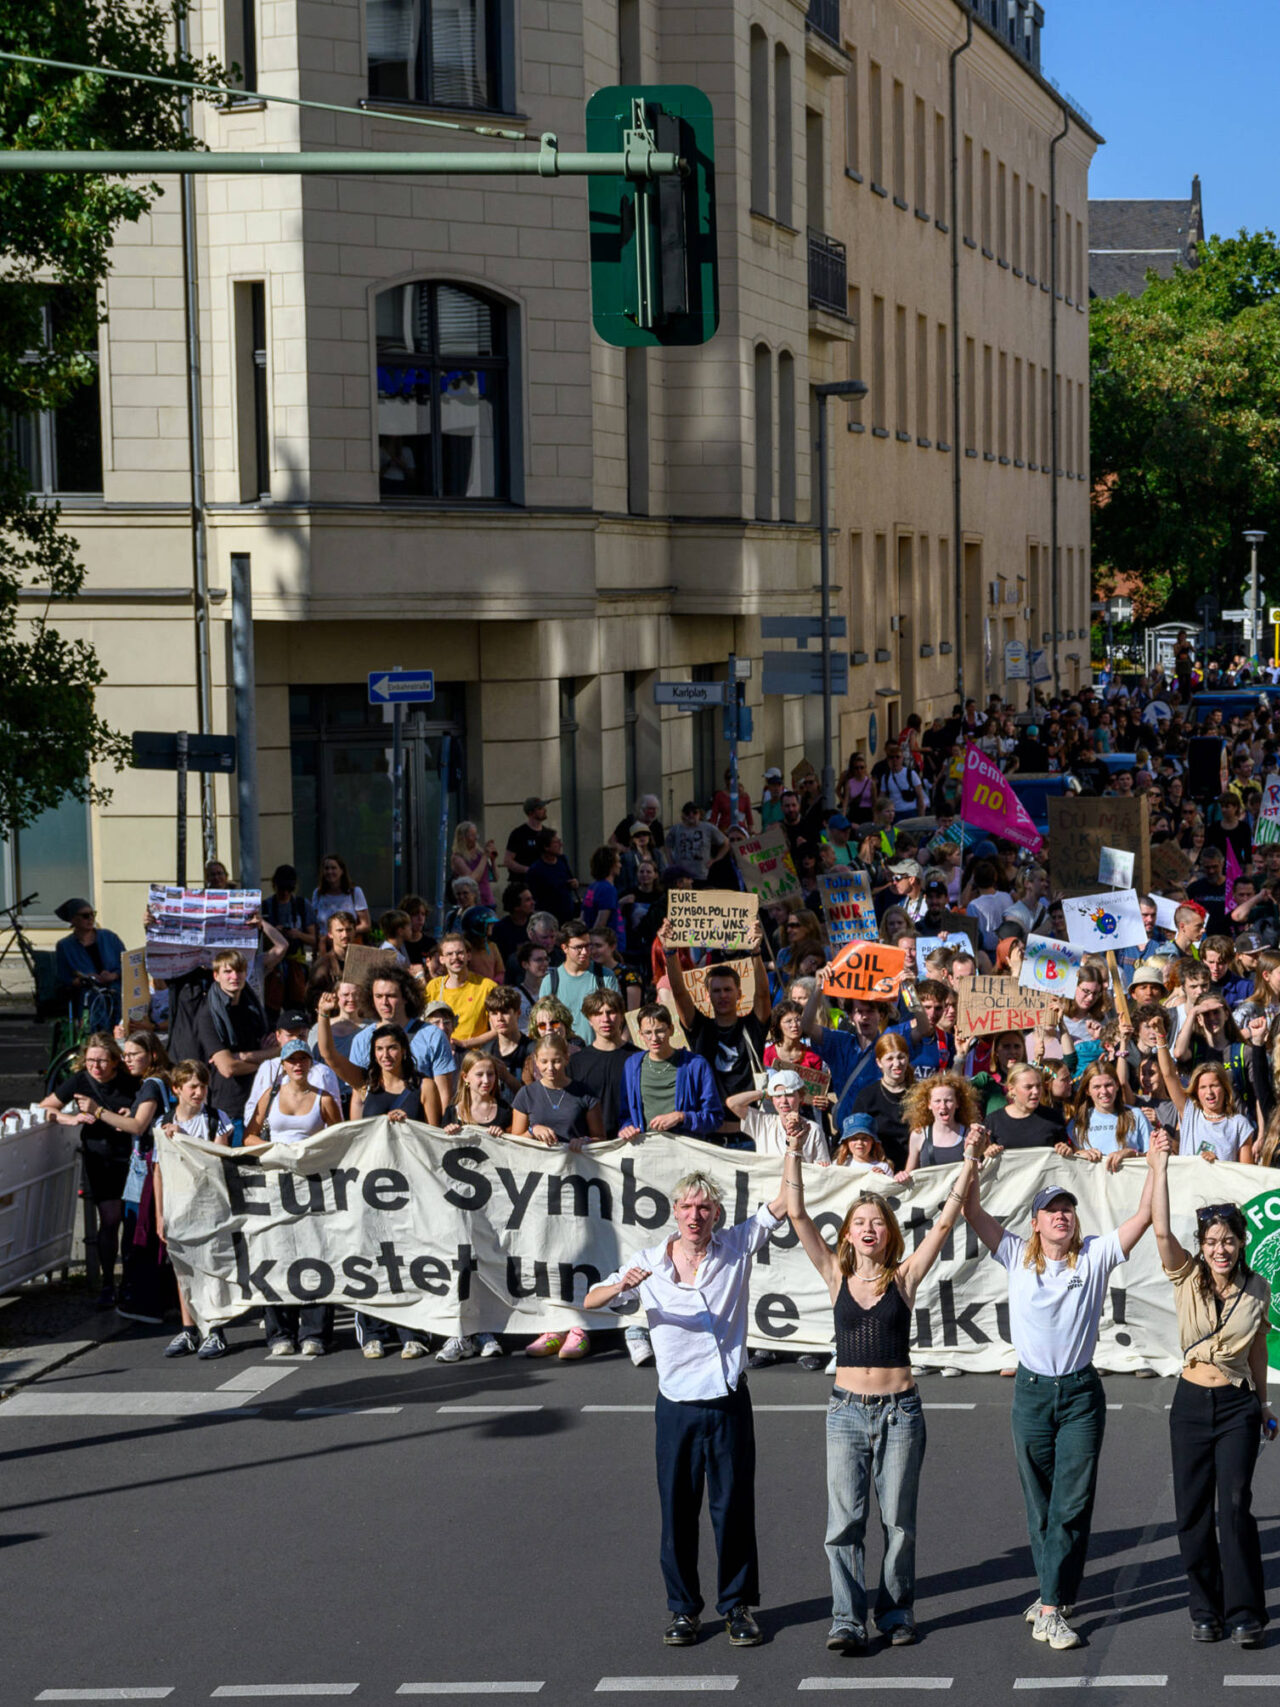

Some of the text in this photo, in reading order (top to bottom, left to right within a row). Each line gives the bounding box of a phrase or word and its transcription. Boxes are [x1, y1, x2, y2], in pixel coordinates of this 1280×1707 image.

[672, 687, 707, 700] Karlplatz
[739, 840, 762, 857] RUN
[671, 893, 697, 903] EURE
[670, 906, 748, 917] SYMBOLPOLITIK
[829, 903, 862, 920] NUR
[670, 918, 744, 930] KOSTET UNS
[671, 930, 688, 942] DIE
[846, 952, 885, 972] OIL
[1046, 959, 1058, 980] B
[829, 970, 894, 993] KILLS
[966, 1009, 1046, 1033] WE RISE
[222, 1155, 409, 1217] Eure
[231, 1231, 477, 1302] kostet
